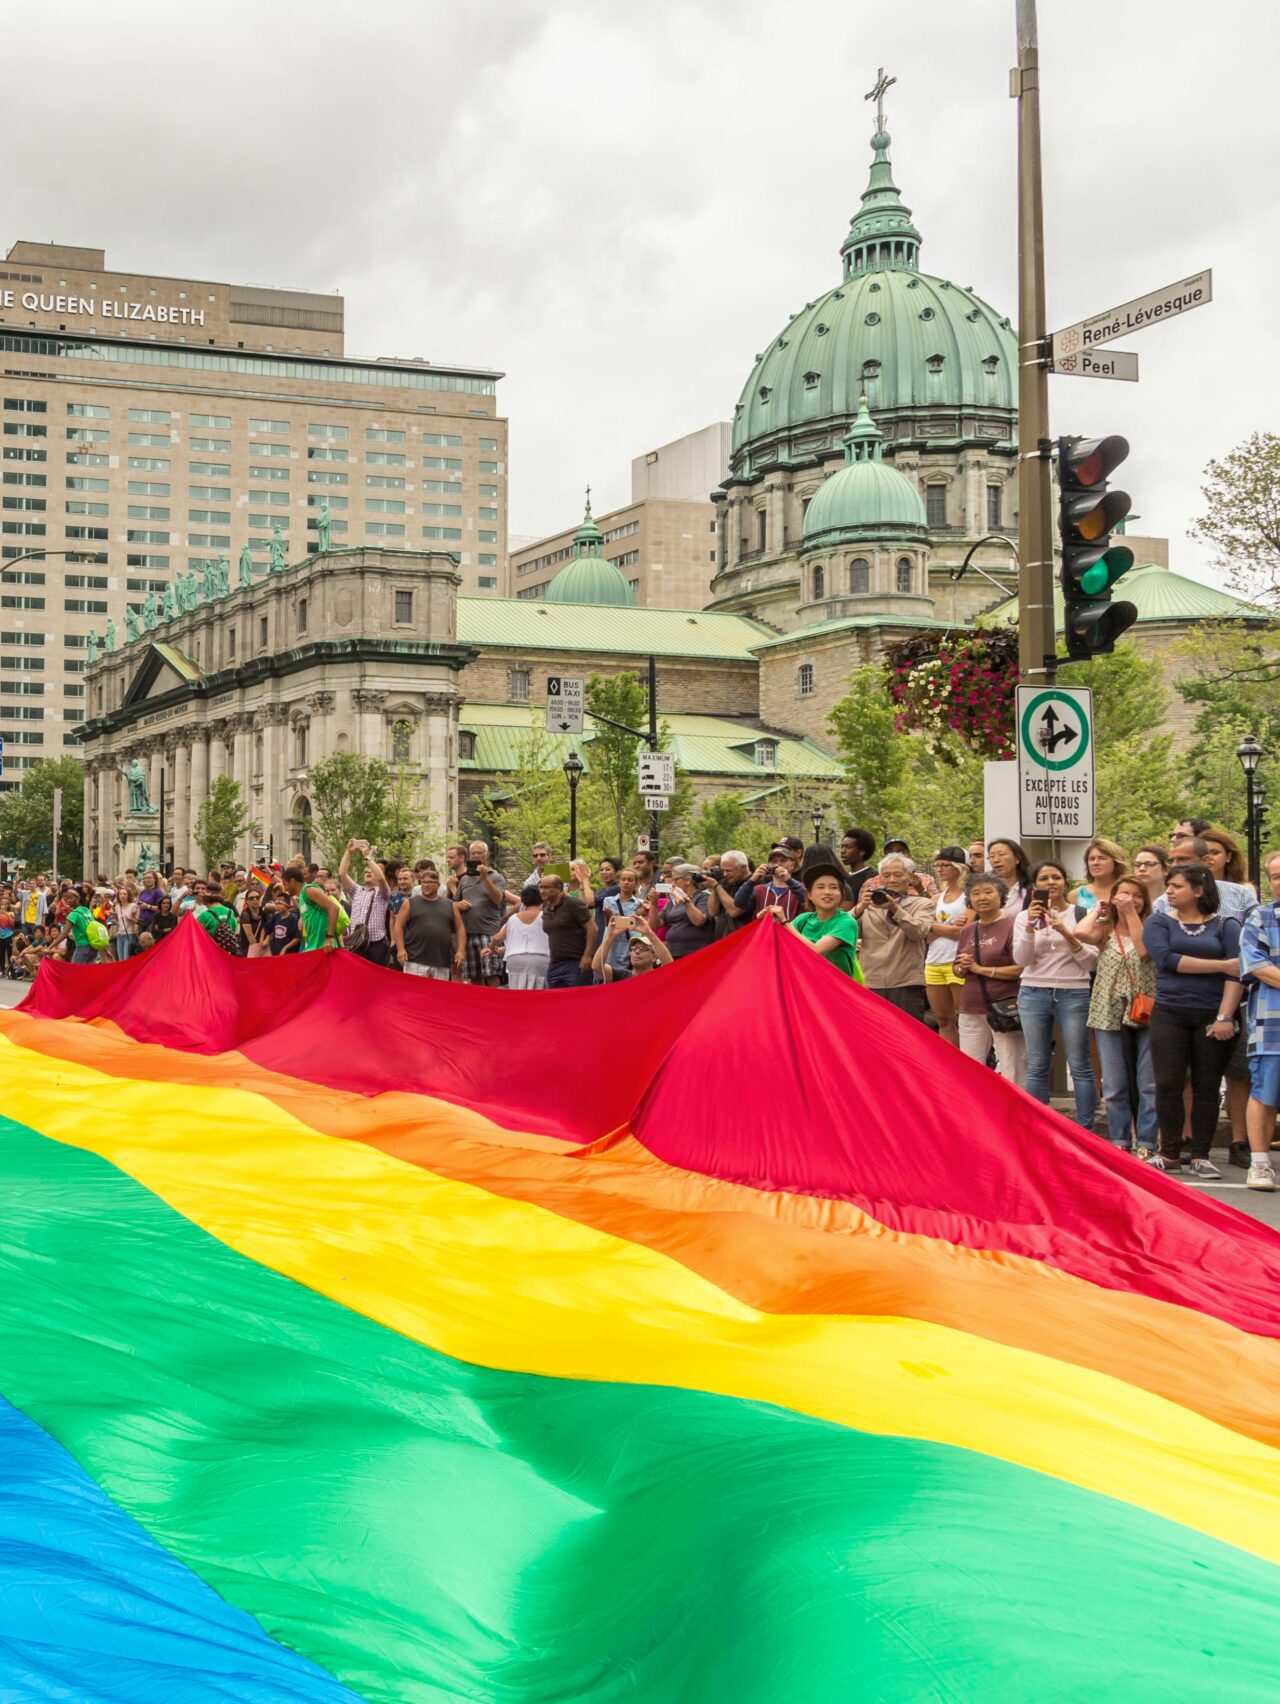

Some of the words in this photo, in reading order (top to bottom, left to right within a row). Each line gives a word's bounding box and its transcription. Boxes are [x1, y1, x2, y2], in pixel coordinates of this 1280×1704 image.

[21, 291, 95, 316] QUEEN
[102, 300, 205, 326] ELIZABETH
[1082, 288, 1203, 346] René-Lévesque
[1082, 358, 1115, 374] Peel
[1025, 776, 1067, 793] EXCEPTÉ
[1071, 780, 1088, 793] LES
[652, 799, 664, 809] 150
[1035, 796, 1080, 809] AUTOBUS
[1035, 812, 1047, 825] ET
[1051, 813, 1079, 826] TAXIS
